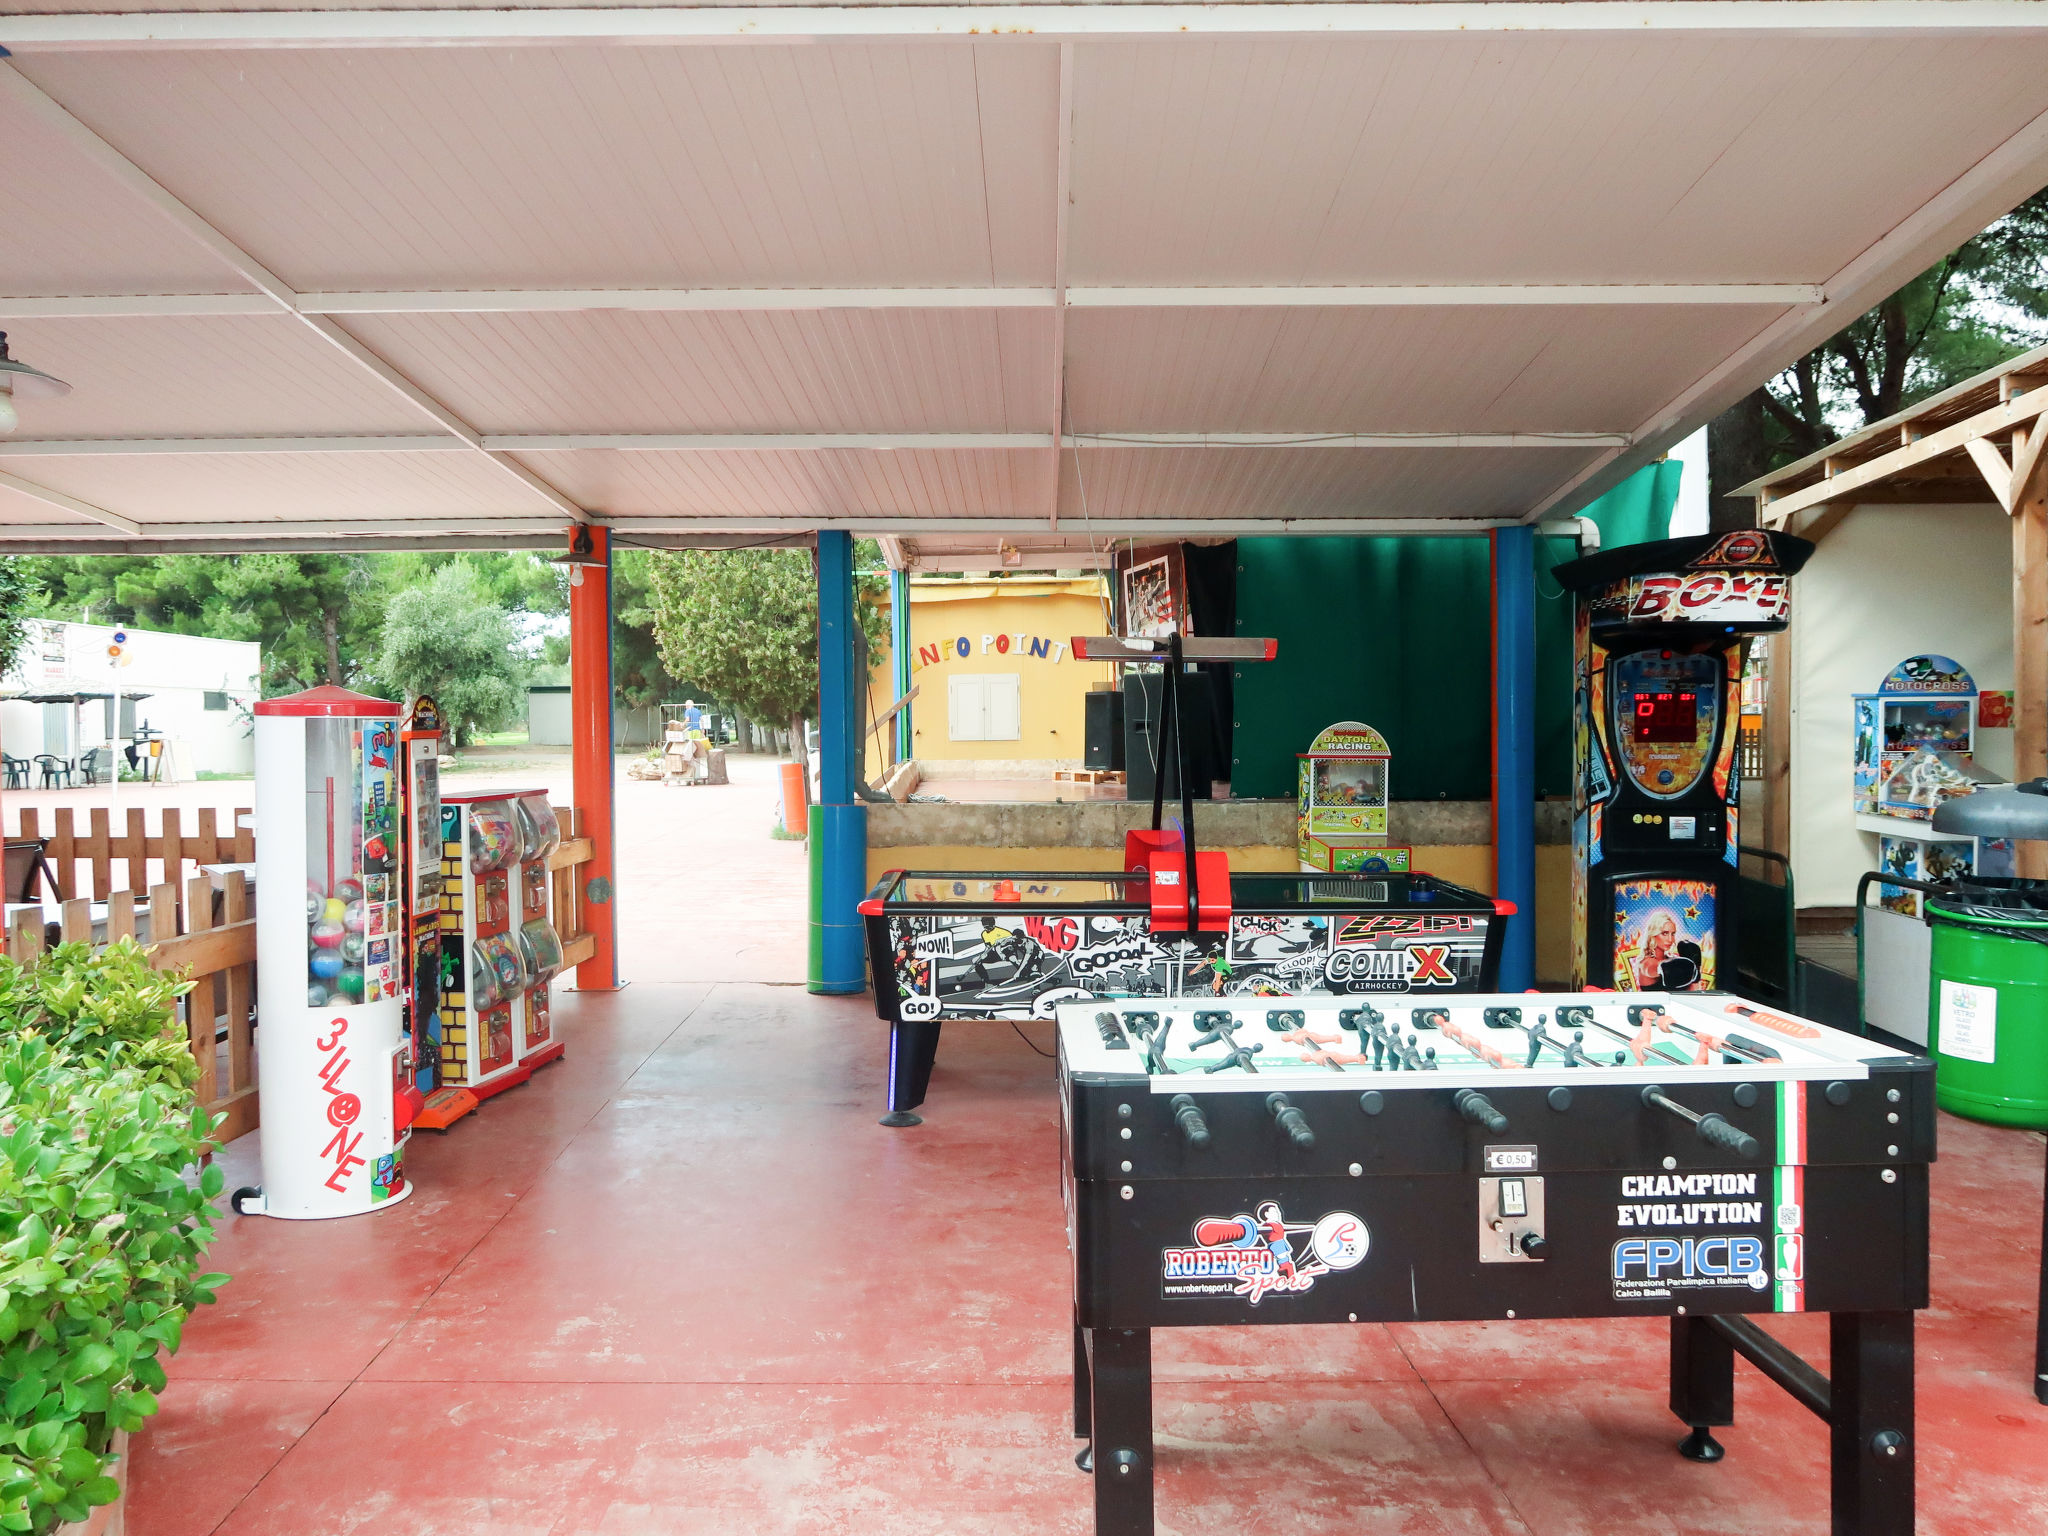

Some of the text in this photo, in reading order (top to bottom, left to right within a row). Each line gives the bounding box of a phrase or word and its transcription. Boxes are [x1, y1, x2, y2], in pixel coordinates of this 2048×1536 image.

[981, 633, 1068, 664] POINT
[1885, 681, 1970, 691] MOTOCROSS
[1240, 916, 1278, 932] CLICK
[918, 936, 950, 955] NOW!
[1073, 942, 1154, 972] GOOOAL
[1281, 956, 1316, 971] FLOOP!
[1330, 946, 1454, 983] COMI-X
[1354, 982, 1402, 990] AIRHOCKEY
[905, 1002, 935, 1014] GO!
[1496, 1154, 1527, 1165] € 0,50
[1622, 1173, 1756, 1197] CHAMPION
[1617, 1202, 1762, 1226] EVOLUTION
[1167, 1250, 1275, 1276] ROBERTO
[1614, 1237, 1763, 1279] FPICB
[1165, 1284, 1233, 1294] www.robertosport.it
[1236, 1263, 1327, 1301] Sport
[1615, 1276, 1748, 1288] Federazione Paralimpica Italiana
[1615, 1289, 1642, 1298] Calcio
